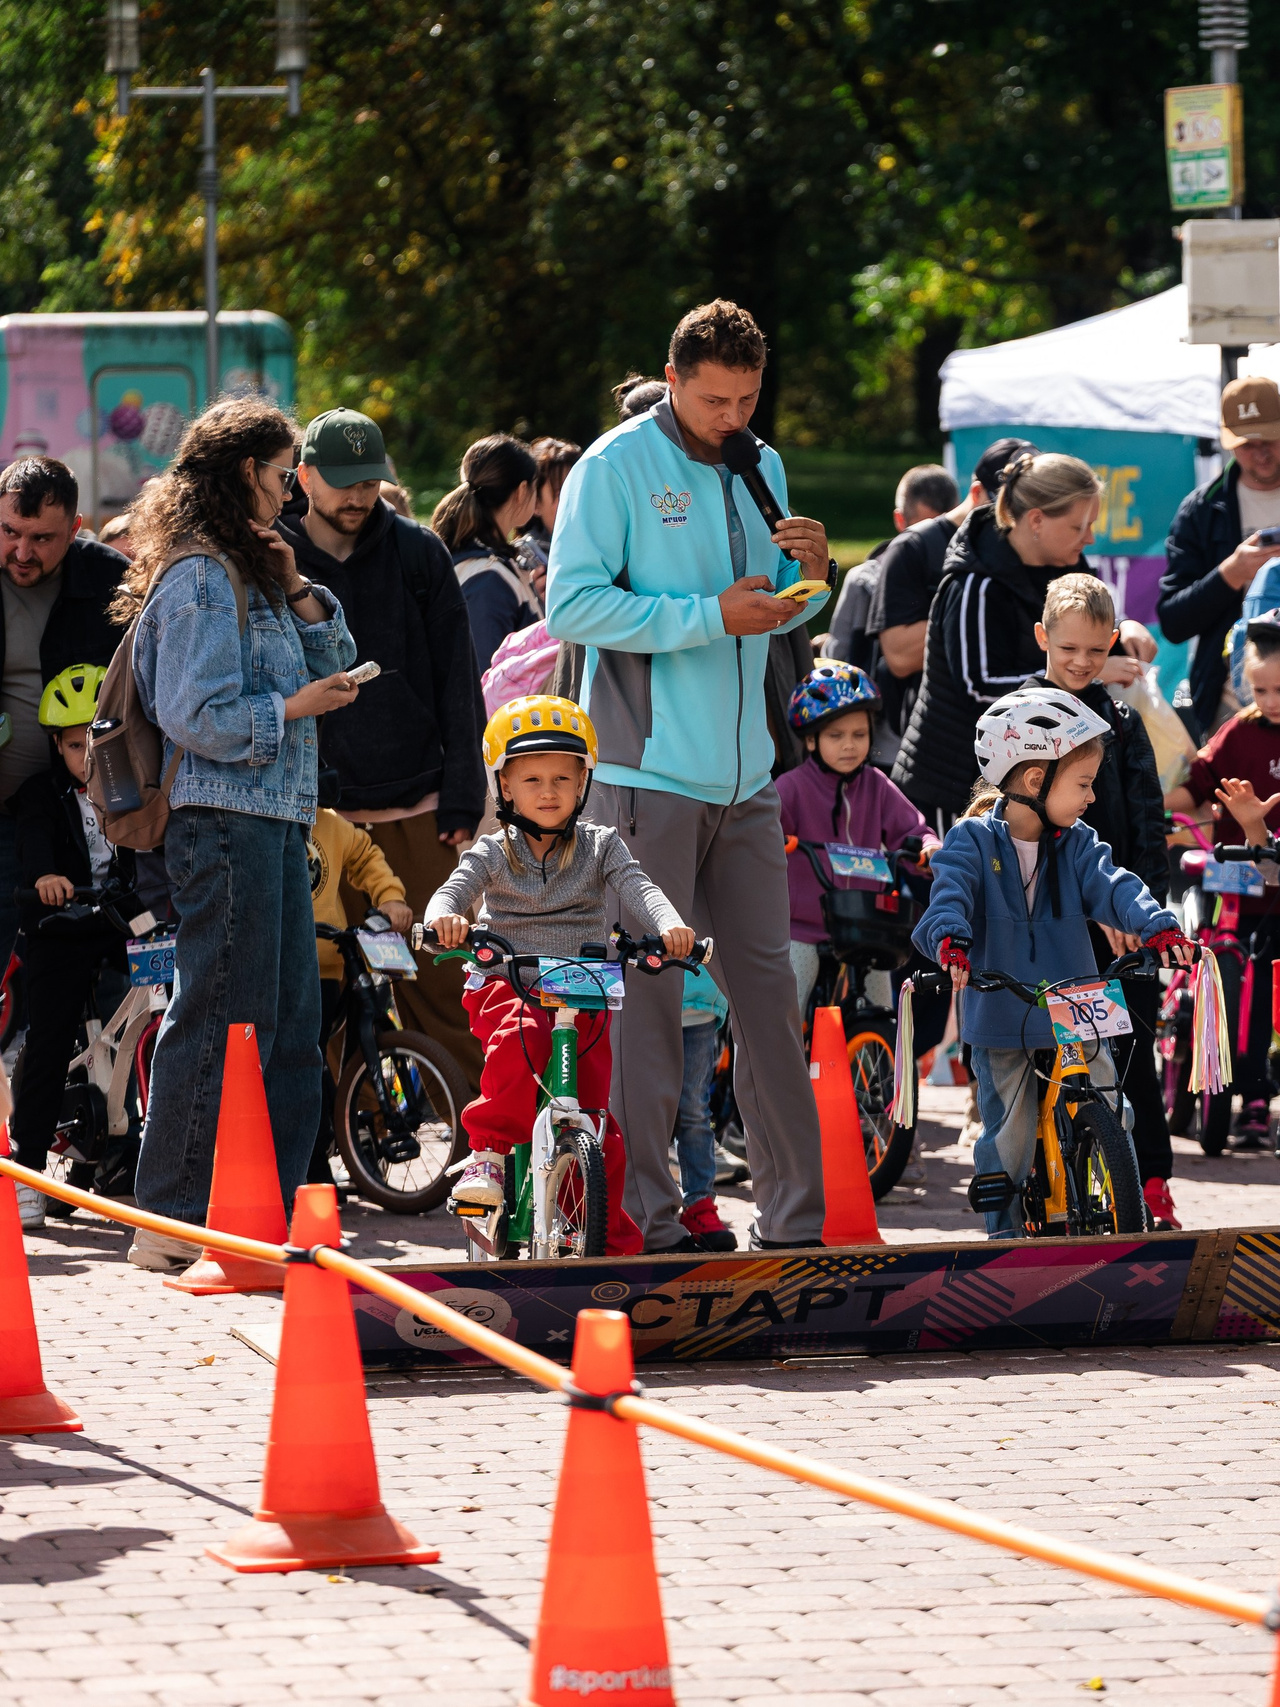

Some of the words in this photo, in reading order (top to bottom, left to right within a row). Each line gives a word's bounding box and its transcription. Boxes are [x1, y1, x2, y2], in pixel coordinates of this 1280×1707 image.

[1237, 401, 1261, 420] LA
[662, 515, 687, 524] МГЦОР
[1024, 743, 1048, 751] CIGNA
[850, 856, 876, 873] 28
[149, 949, 176, 971] 68
[561, 969, 606, 986] 198
[1068, 999, 1109, 1025] 105
[561, 1042, 571, 1085] woom
[620, 1284, 905, 1330] СТАРТ
